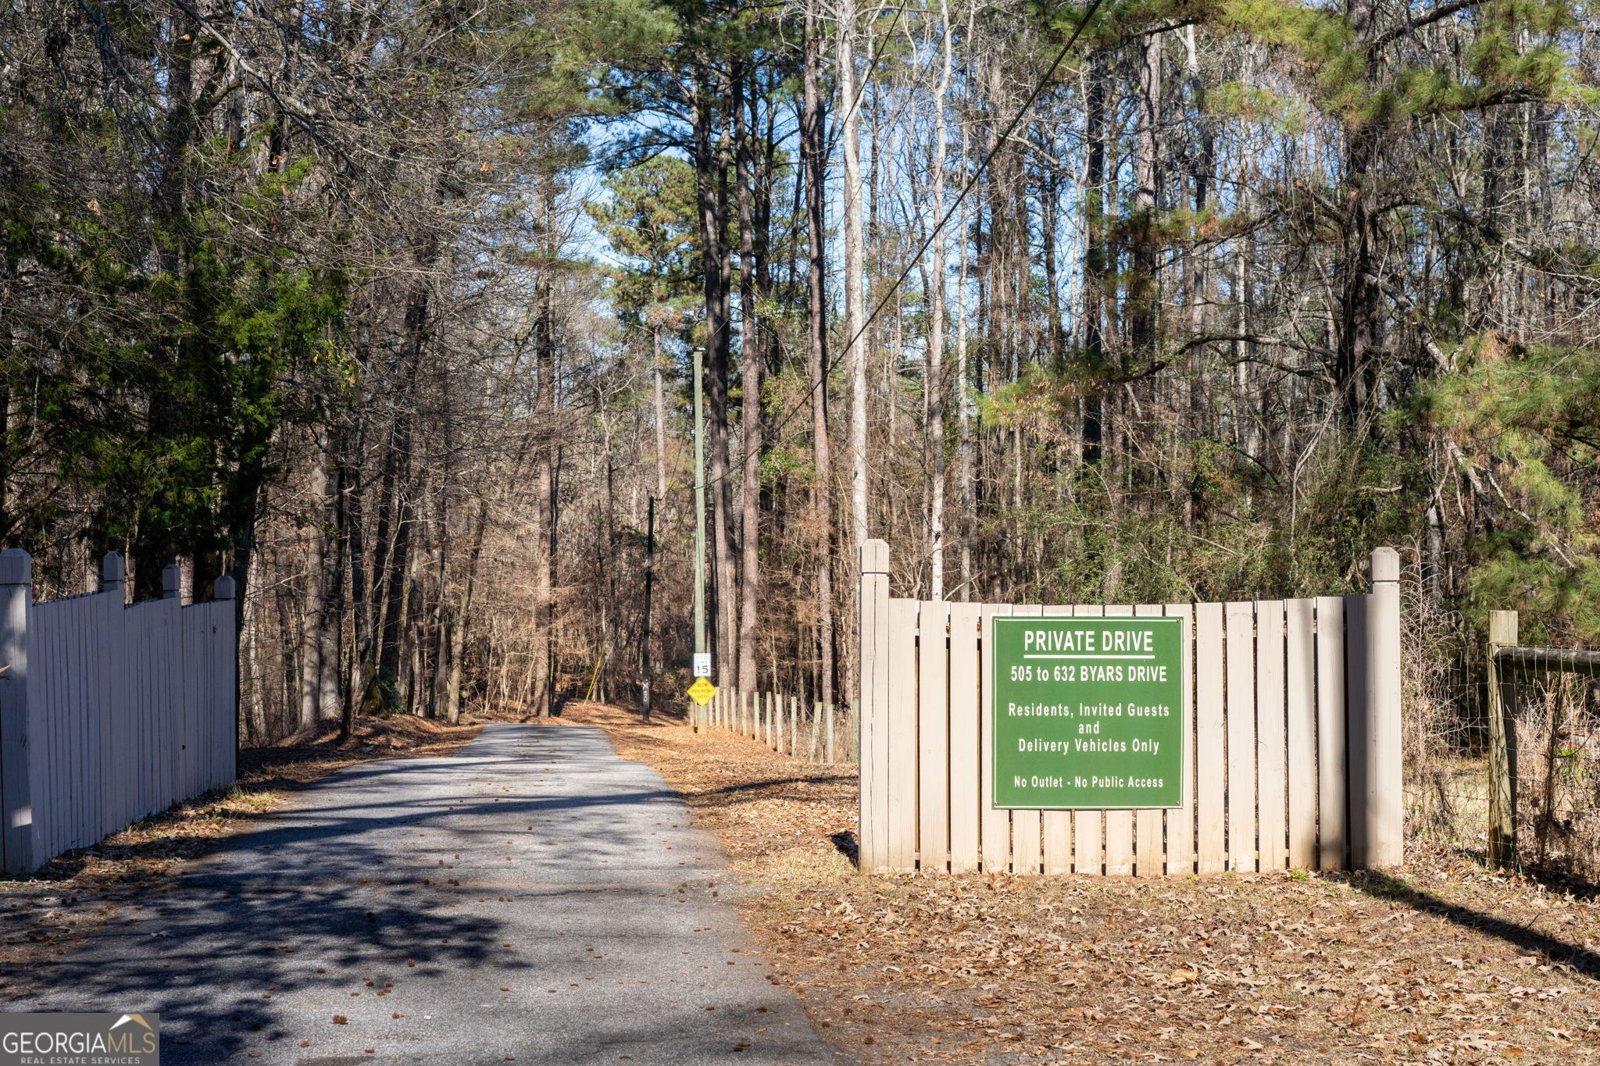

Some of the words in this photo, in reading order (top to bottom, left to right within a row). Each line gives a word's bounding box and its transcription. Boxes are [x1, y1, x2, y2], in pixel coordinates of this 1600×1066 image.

[1024, 630, 1096, 652] PRIVATE
[1102, 630, 1154, 652] DRIVE
[697, 665, 709, 674] 15
[1010, 665, 1033, 682] 505
[1036, 666, 1050, 682] to
[1053, 665, 1076, 682] 632
[1080, 665, 1124, 682] BYARS
[1128, 665, 1168, 682] DRIVE
[1008, 702, 1074, 718] Residents,
[1079, 702, 1122, 717] Invited
[1127, 702, 1170, 717] Guests
[1078, 720, 1101, 735] and
[1018, 738, 1070, 756] Delivery
[1074, 738, 1127, 752] Vehicles
[1131, 737, 1160, 756] Only
[1013, 775, 1028, 788] No
[1031, 775, 1064, 789] Outlet
[1074, 776, 1089, 788] No
[1091, 775, 1125, 789] Public
[1127, 776, 1165, 789] Access
